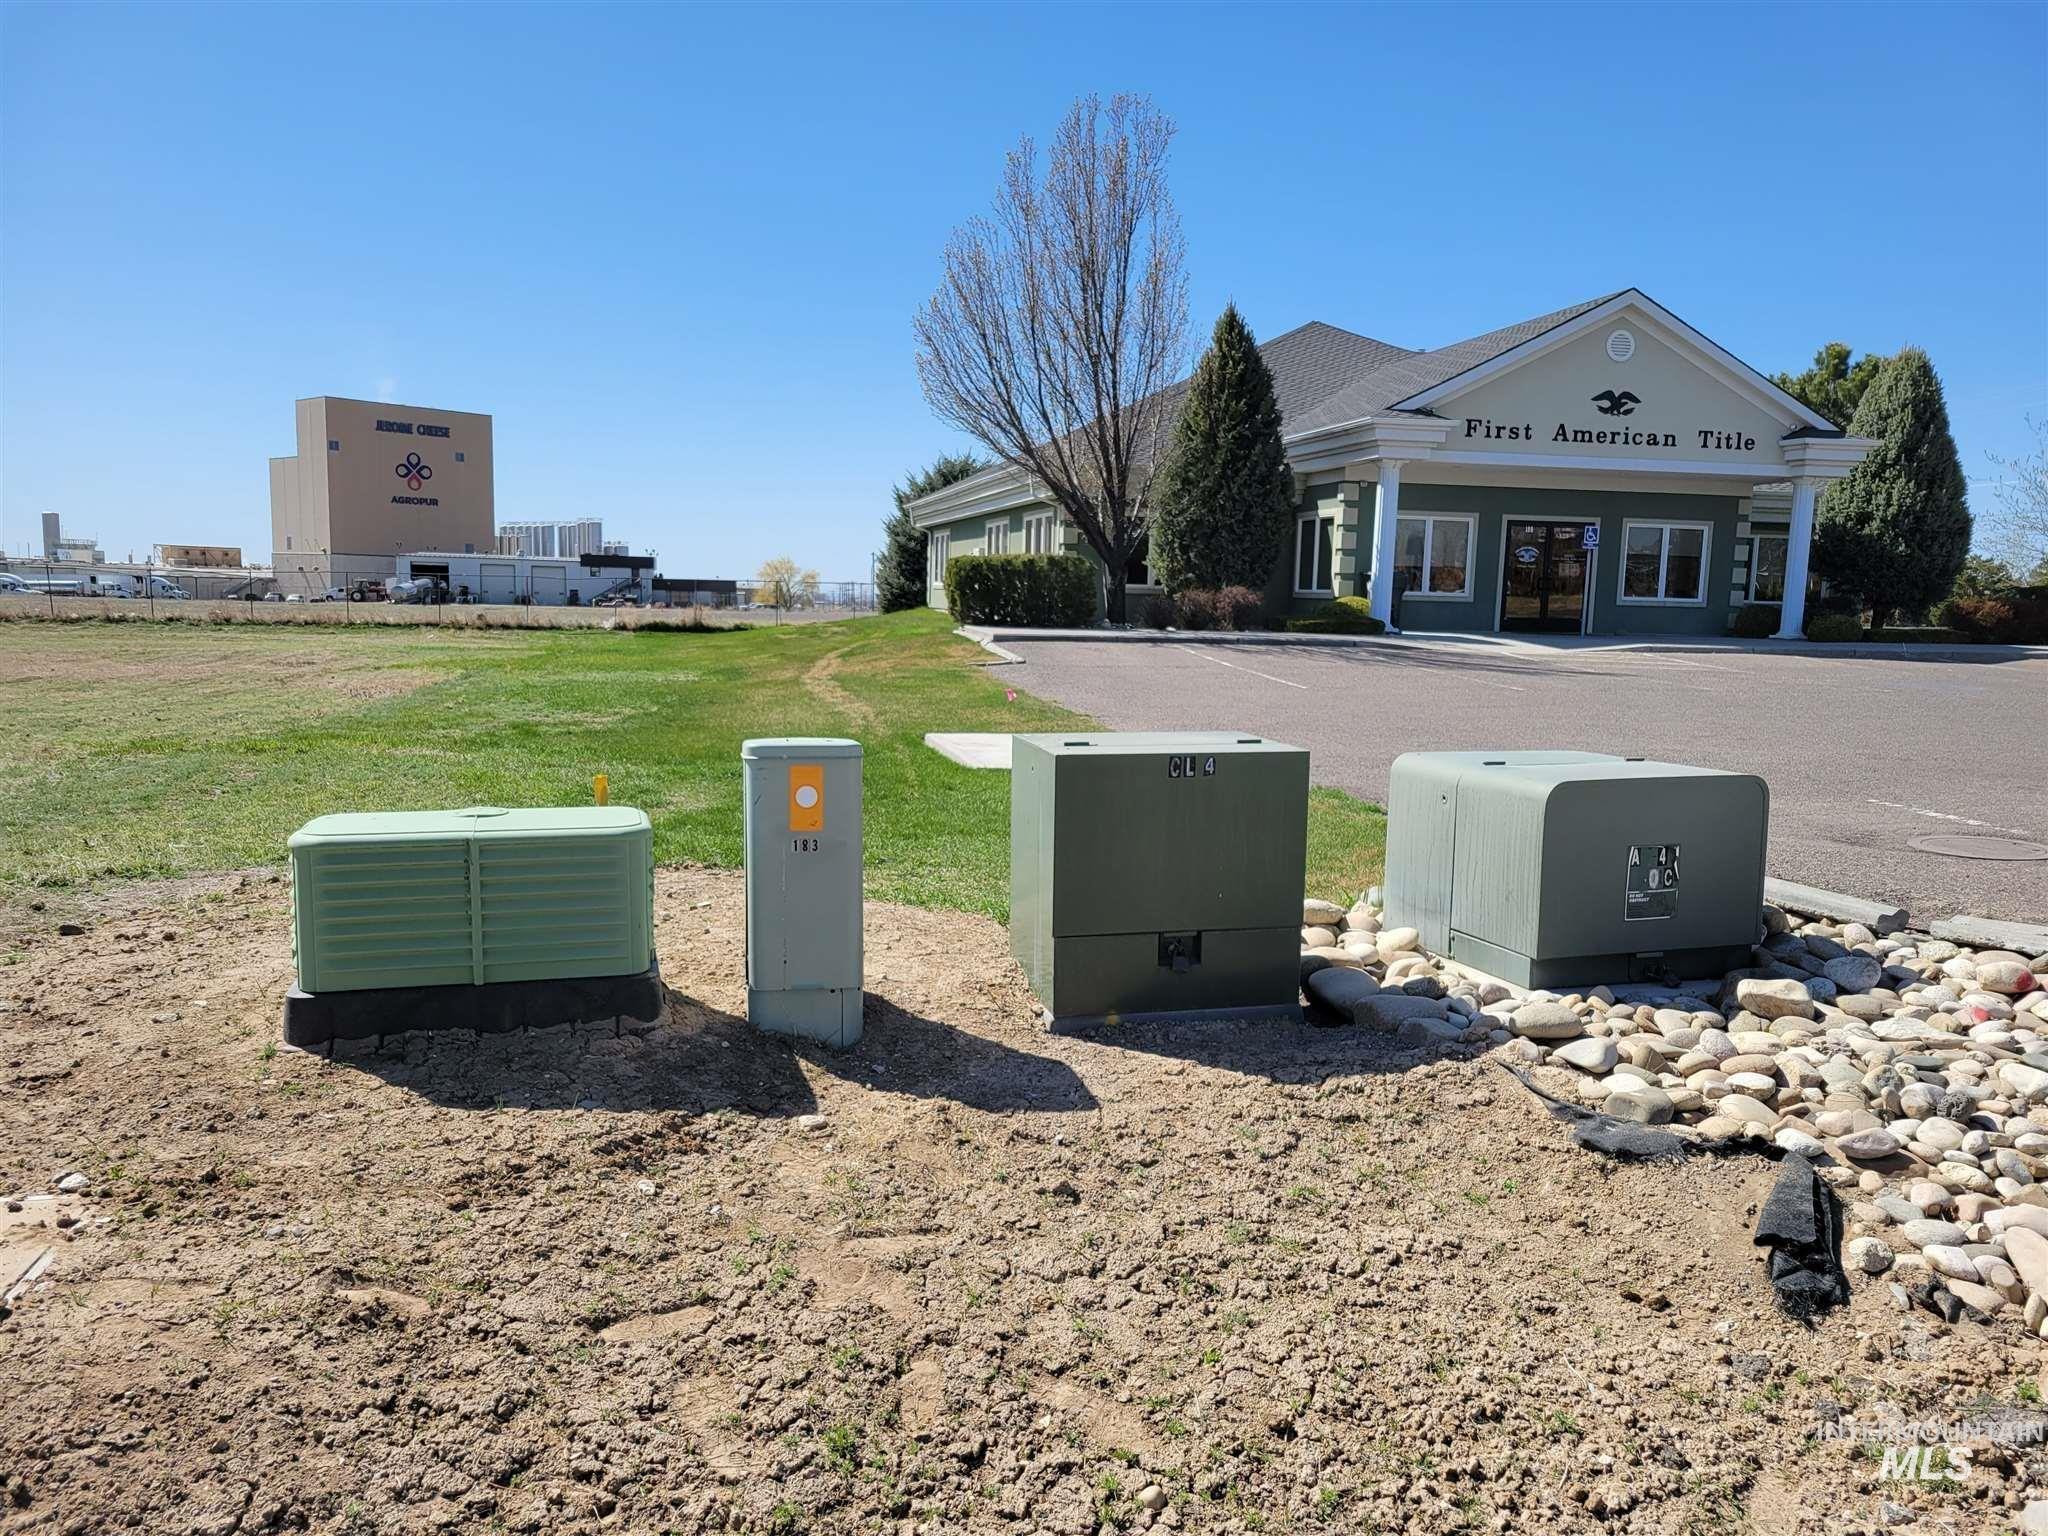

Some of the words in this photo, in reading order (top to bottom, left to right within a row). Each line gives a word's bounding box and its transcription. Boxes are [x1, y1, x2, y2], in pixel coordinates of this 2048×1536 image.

[1464, 418, 1533, 441] First
[1551, 423, 1678, 447] American
[1698, 430, 1757, 451] Title
[391, 495, 439, 507] AGROPUR
[1169, 757, 1195, 778] CL
[1204, 757, 1216, 775] 4
[793, 839, 819, 852] 183
[1631, 848, 1640, 866] A
[1659, 847, 1667, 866] 4
